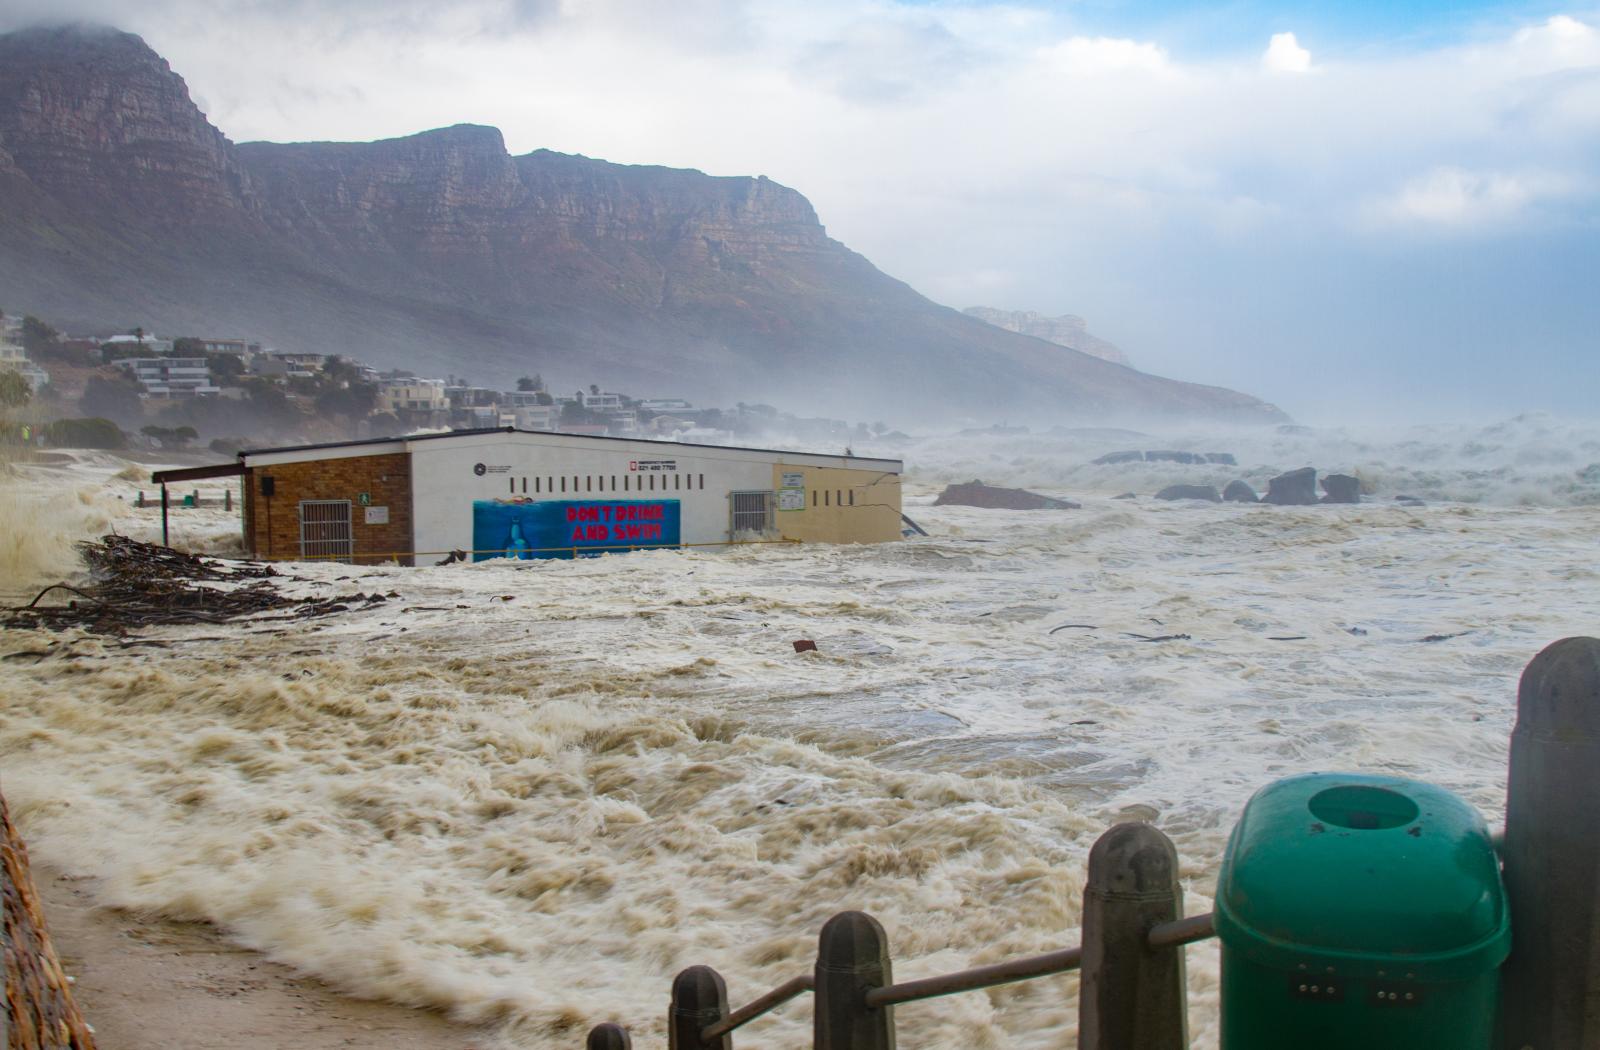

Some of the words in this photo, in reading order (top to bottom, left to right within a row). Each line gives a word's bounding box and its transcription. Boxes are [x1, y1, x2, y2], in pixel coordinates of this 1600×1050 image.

[566, 505, 612, 522] DON'T
[615, 504, 664, 521] DRINK
[572, 524, 608, 541] AND
[613, 523, 661, 541] SWIM
